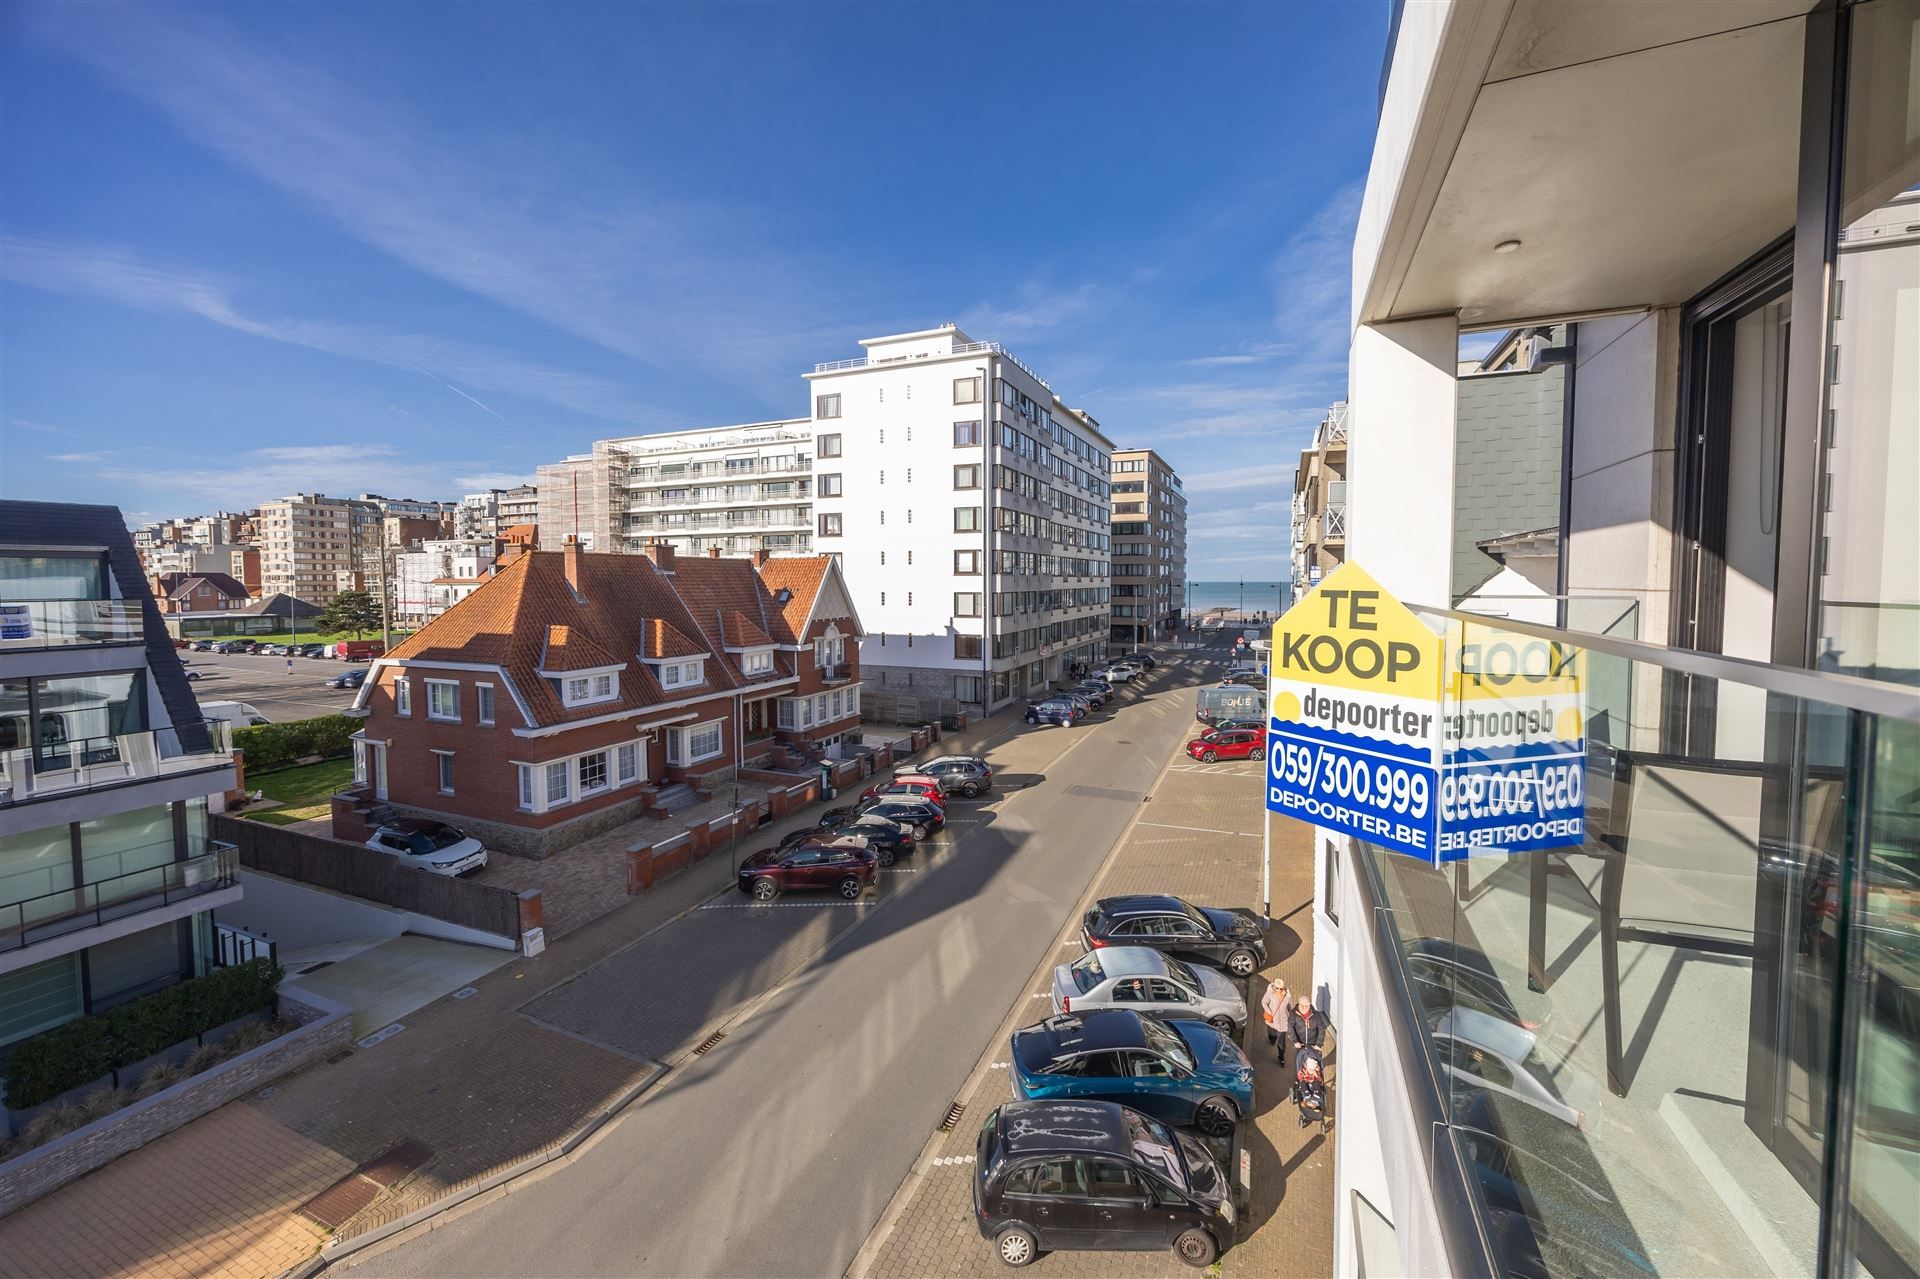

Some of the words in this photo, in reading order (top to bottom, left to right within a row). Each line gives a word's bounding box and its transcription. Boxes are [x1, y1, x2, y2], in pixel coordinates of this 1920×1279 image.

[1320, 590, 1379, 631] TE
[1282, 632, 1421, 683] KOOP
[1303, 687, 1432, 739] depoorter
[1271, 740, 1429, 819] 059/300.999
[1270, 786, 1427, 849] DEPOORTER.BE
